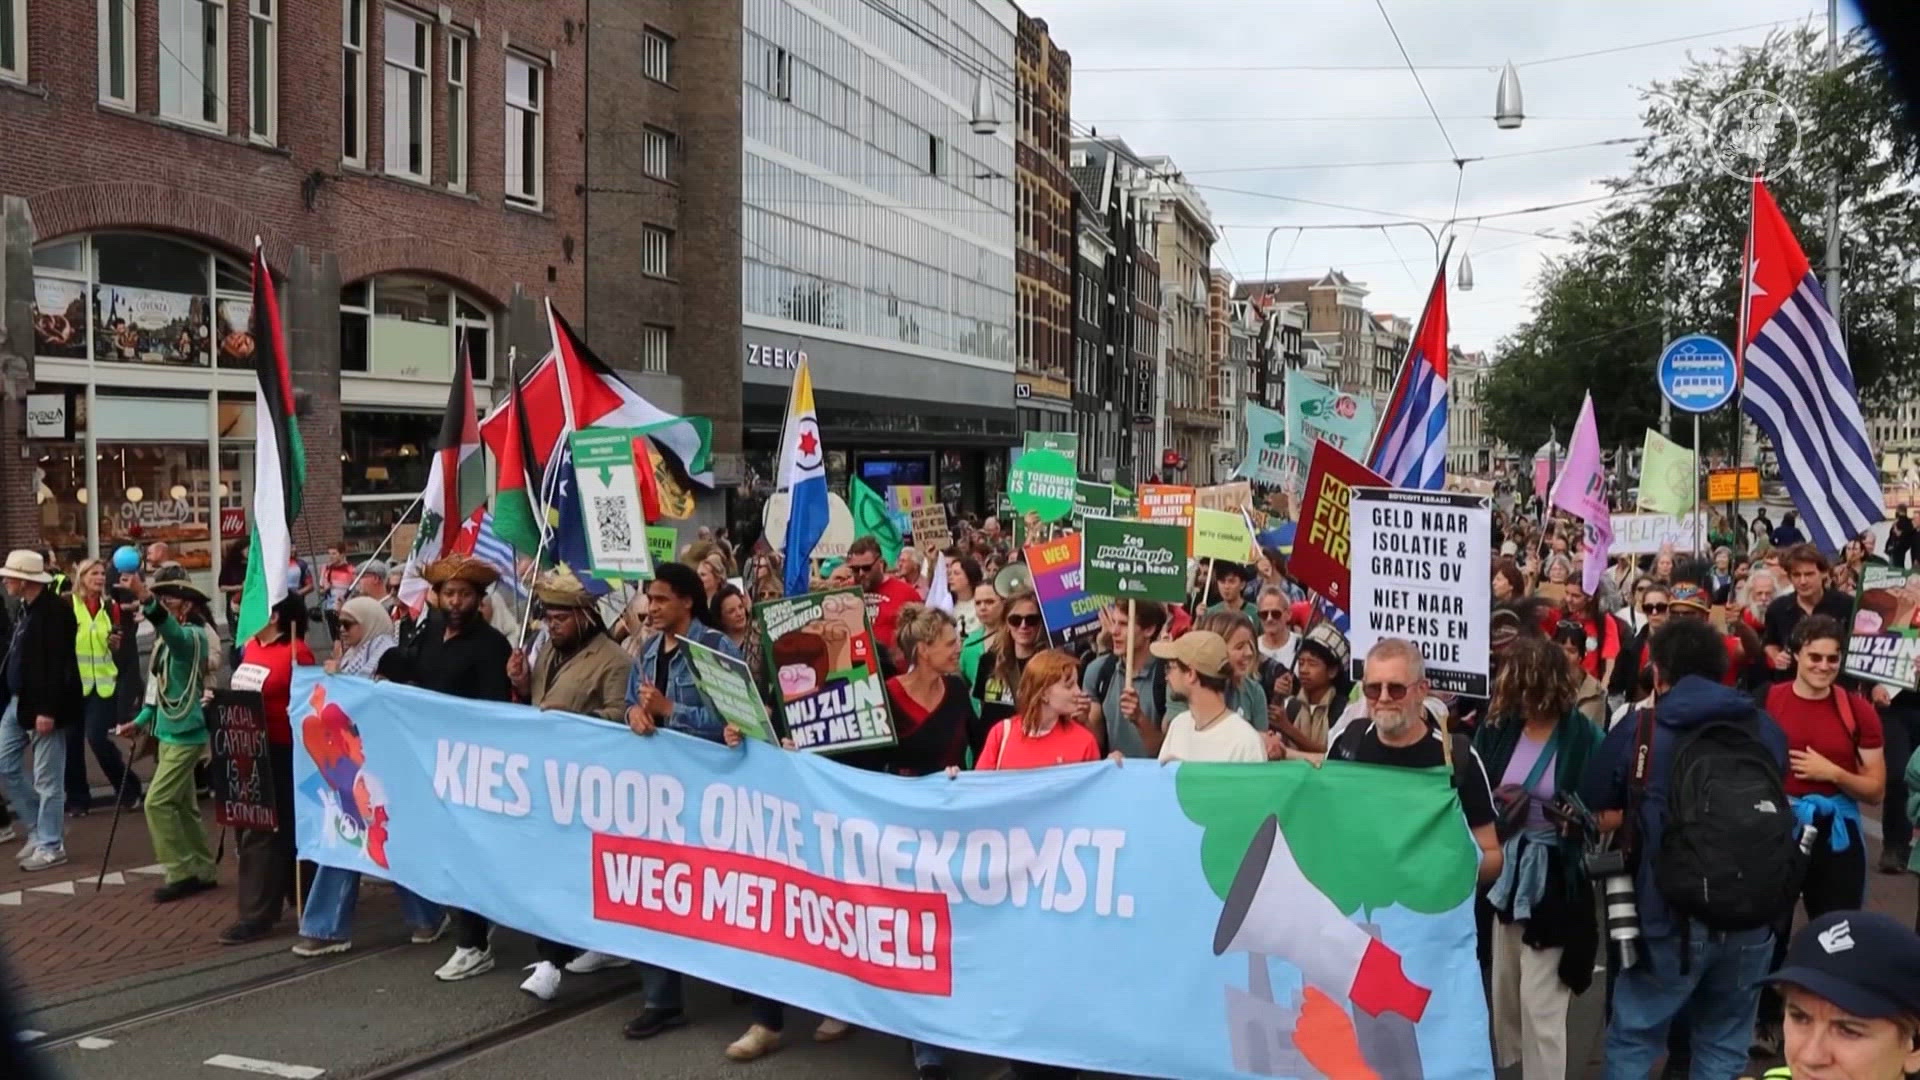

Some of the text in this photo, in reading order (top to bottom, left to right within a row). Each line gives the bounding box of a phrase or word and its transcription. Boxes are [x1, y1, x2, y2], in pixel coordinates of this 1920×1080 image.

[1139, 360, 1149, 412] HOTEL
[28, 408, 63, 422] OVENZA
[1258, 449, 1308, 477] PROT
[1010, 480, 1024, 494] IS
[1028, 482, 1074, 501] GROEN
[1012, 469, 1075, 487] DE TOEKOMST
[1320, 476, 1350, 508] MO
[121, 500, 189, 521] OVENZA
[222, 513, 244, 532] illy
[1314, 501, 1350, 537] FUE
[1372, 507, 1468, 534] GELD NAAR
[1122, 533, 1144, 547] Zeg
[1309, 520, 1350, 570] FIR
[1373, 532, 1467, 559] ISOLATIE &
[1042, 544, 1070, 566] WEG
[1090, 558, 1180, 575] waar ga je heen?
[1097, 545, 1174, 565] poolkapje
[1060, 569, 1082, 590] WE
[1371, 556, 1462, 582] GRATIS OV
[1071, 594, 1115, 617] ECONO
[1374, 588, 1464, 616] NIET NAAR
[1369, 611, 1468, 640] WAPENS EN
[1848, 635, 1920, 659] WIJ ZIJN
[1845, 653, 1874, 672] MET
[784, 672, 885, 727] WIJ ZIJN
[217, 705, 256, 728] RACIAL
[791, 706, 892, 748] MET MEER
[215, 728, 268, 758] CAPITALISM
[226, 759, 260, 783] IS A
[228, 781, 262, 801] MASS
[225, 800, 275, 828] EXTINCTION
[433, 738, 1135, 918] KIES VOOR ONZE TOEKOMST.
[601, 851, 937, 972] WEG MET FOSSIEL!
